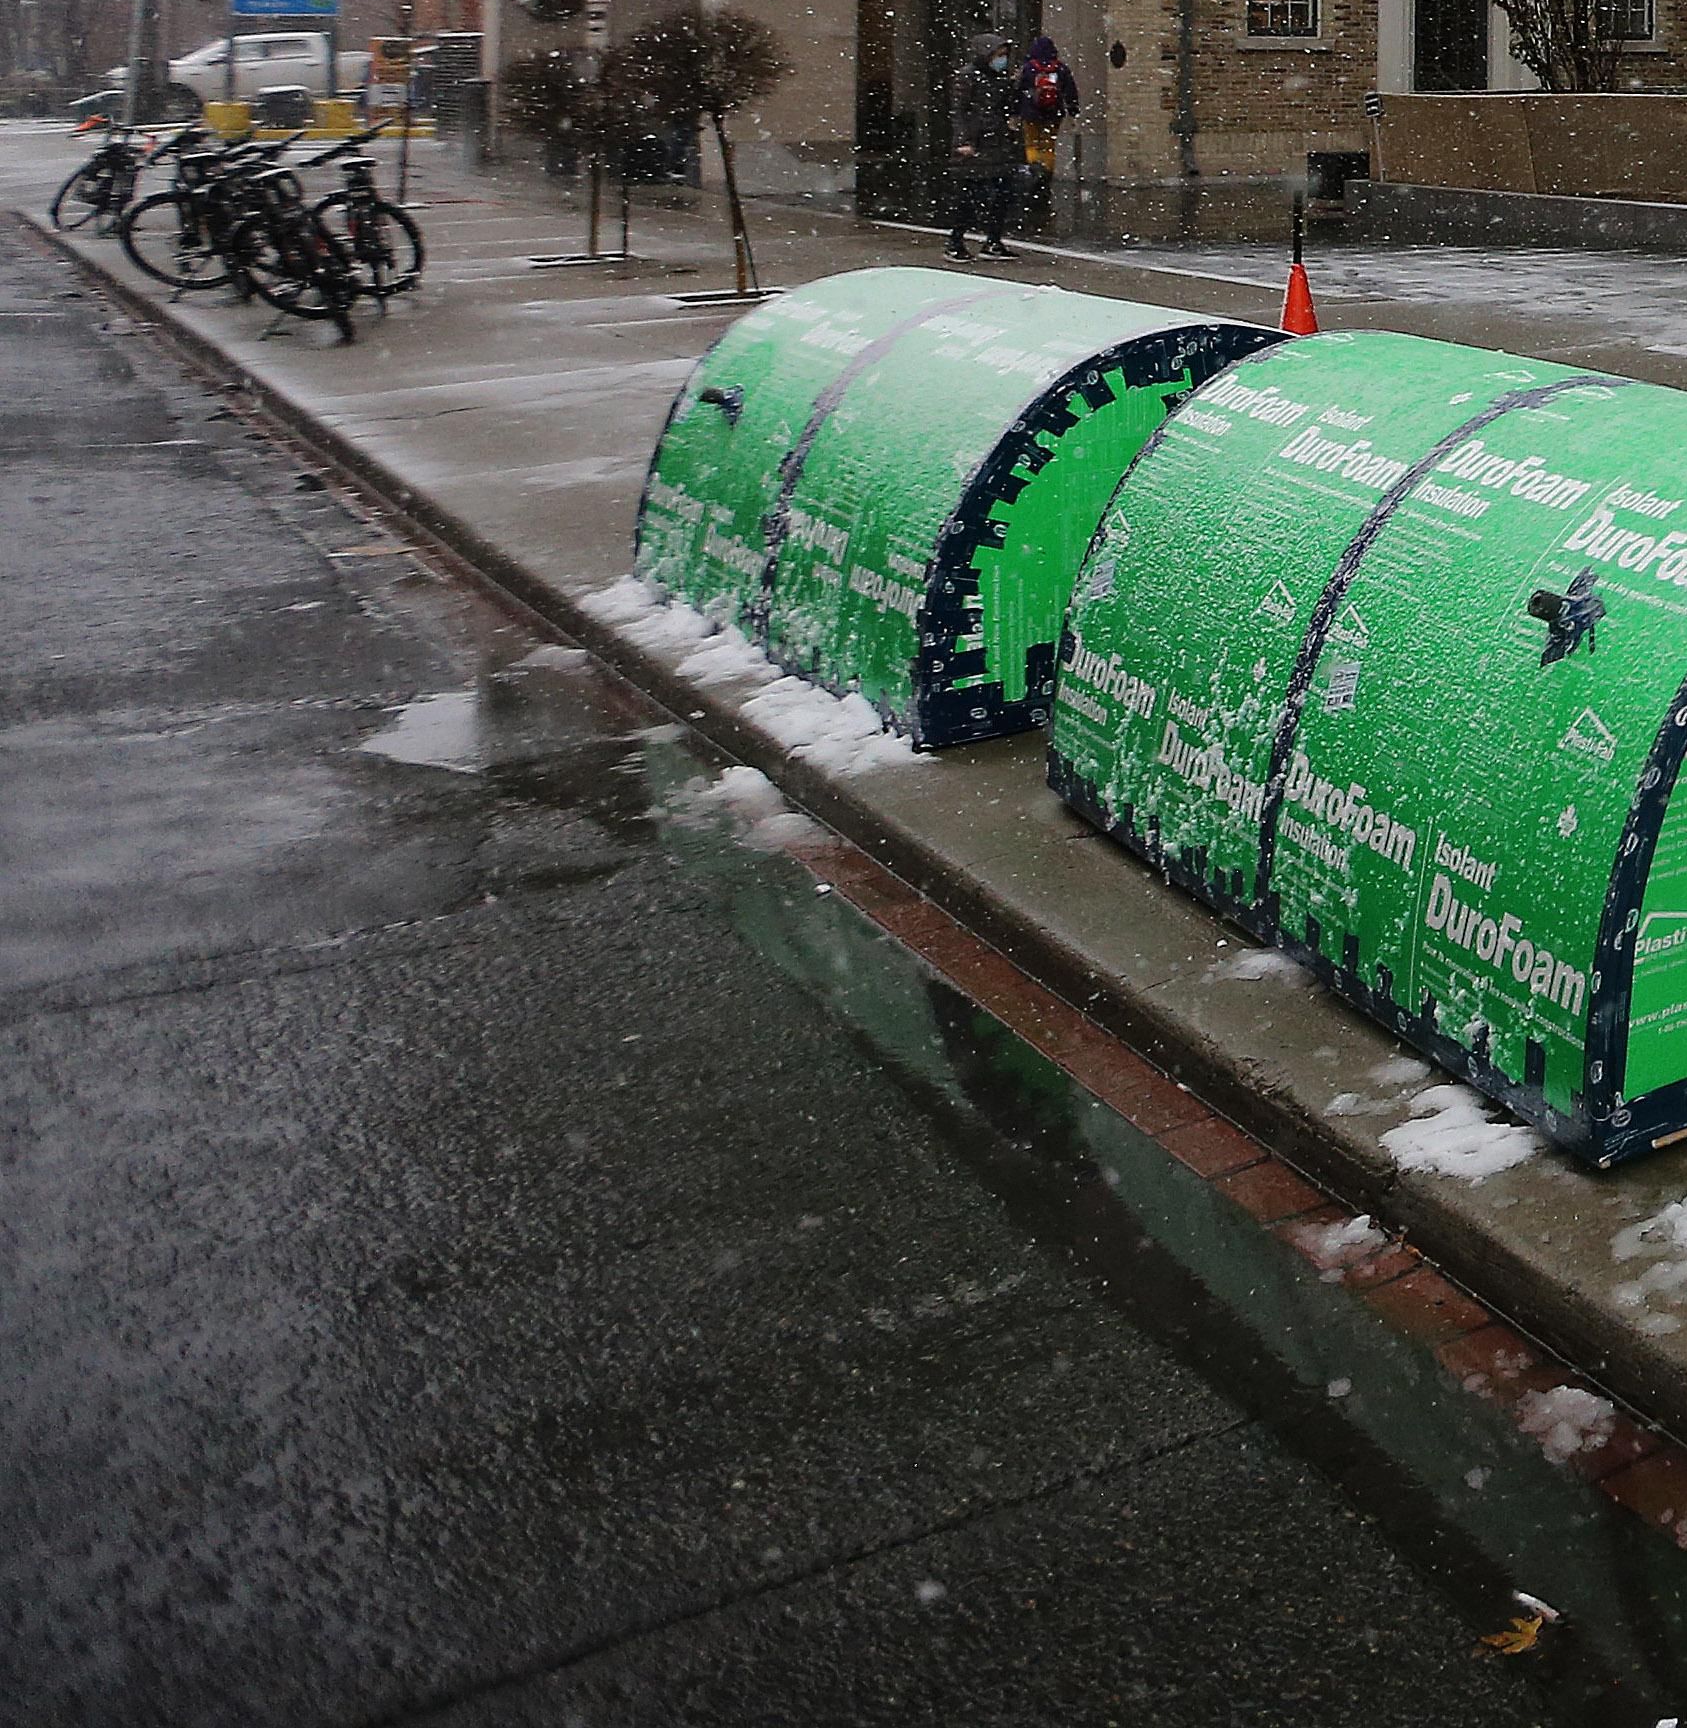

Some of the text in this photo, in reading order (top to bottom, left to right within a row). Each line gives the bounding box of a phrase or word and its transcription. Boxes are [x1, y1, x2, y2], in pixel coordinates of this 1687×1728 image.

[1197, 373, 1310, 427] DuroFoam
[1278, 424, 1409, 492] DuroFoam
[1436, 440, 1592, 510] DuroFoam
[1411, 476, 1491, 520] Insulation
[1604, 482, 1686, 520] Isolant
[1279, 807, 1350, 874] Insulation
[1285, 750, 1418, 874] DuroFoam
[1433, 830, 1499, 893] Isolant
[1424, 872, 1587, 1017] DuroFoam
